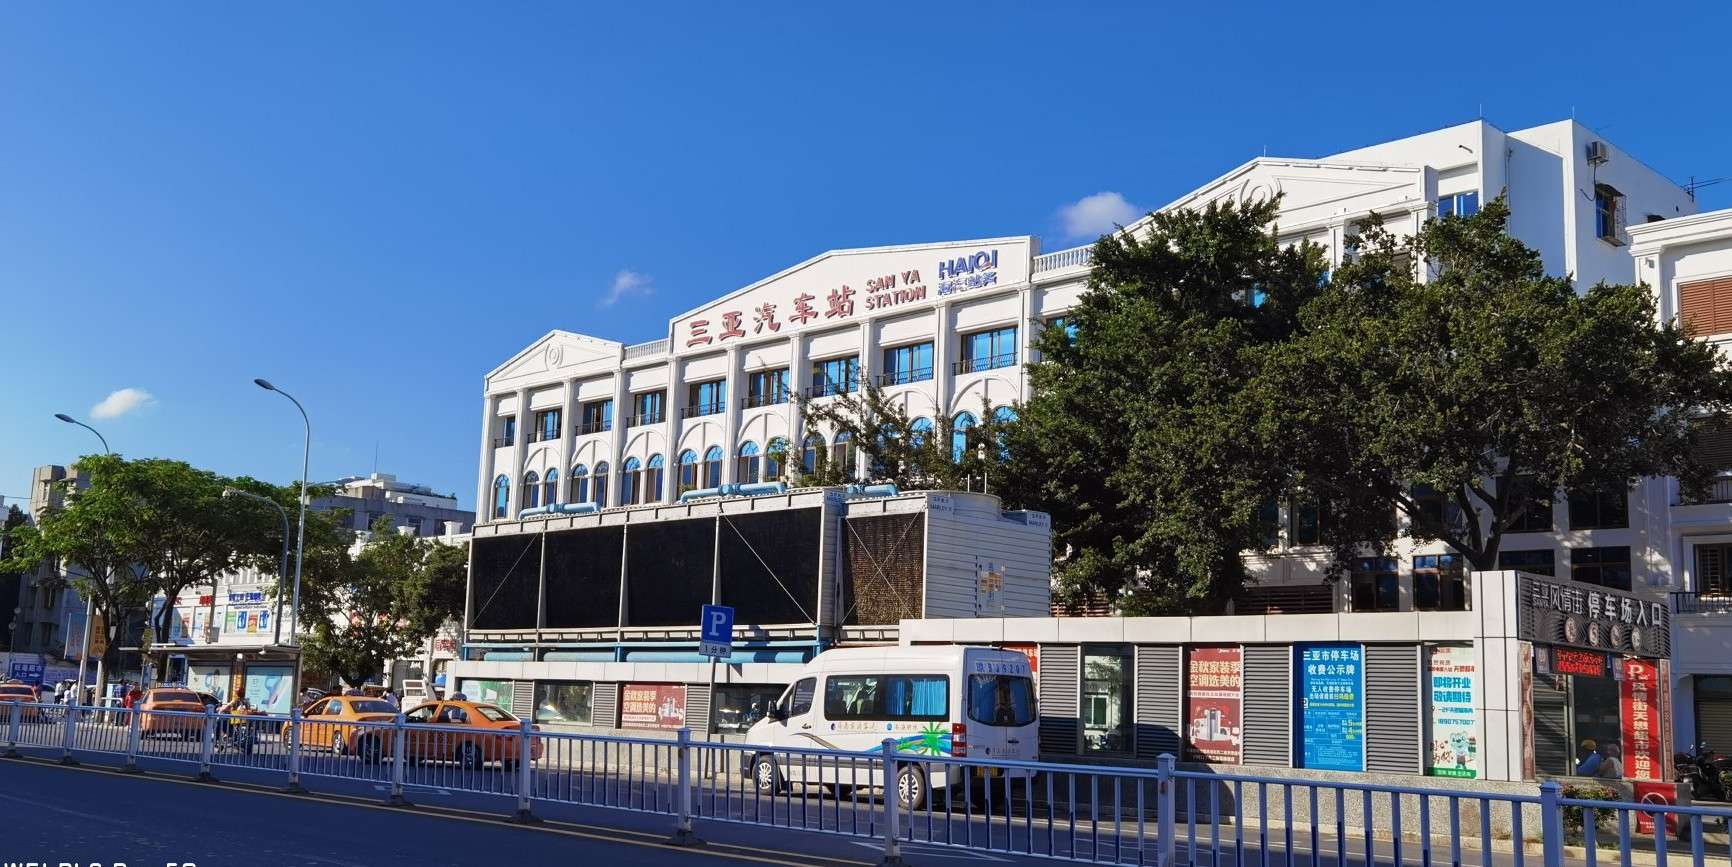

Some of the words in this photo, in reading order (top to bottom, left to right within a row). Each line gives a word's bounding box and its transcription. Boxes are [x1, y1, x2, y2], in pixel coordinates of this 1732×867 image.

[939, 250, 998, 280] HAIQI
[866, 275, 895, 294] SAN
[901, 270, 921, 285] YA
[865, 285, 927, 310] STATION
[686, 285, 856, 348] 三亚汽车站
[1587, 591, 1662, 627] 停车场入口
[708, 611, 727, 637] P
[1303, 650, 1359, 661] 三亚市停车场
[1190, 660, 1240, 674] 金秋家装季
[1307, 664, 1355, 675] 收费公示牌
[1629, 664, 1645, 680] P
[1190, 674, 1240, 688] 空调选美的
[1433, 676, 1471, 688] 即将开业
[1433, 690, 1471, 703] 敬请期待
